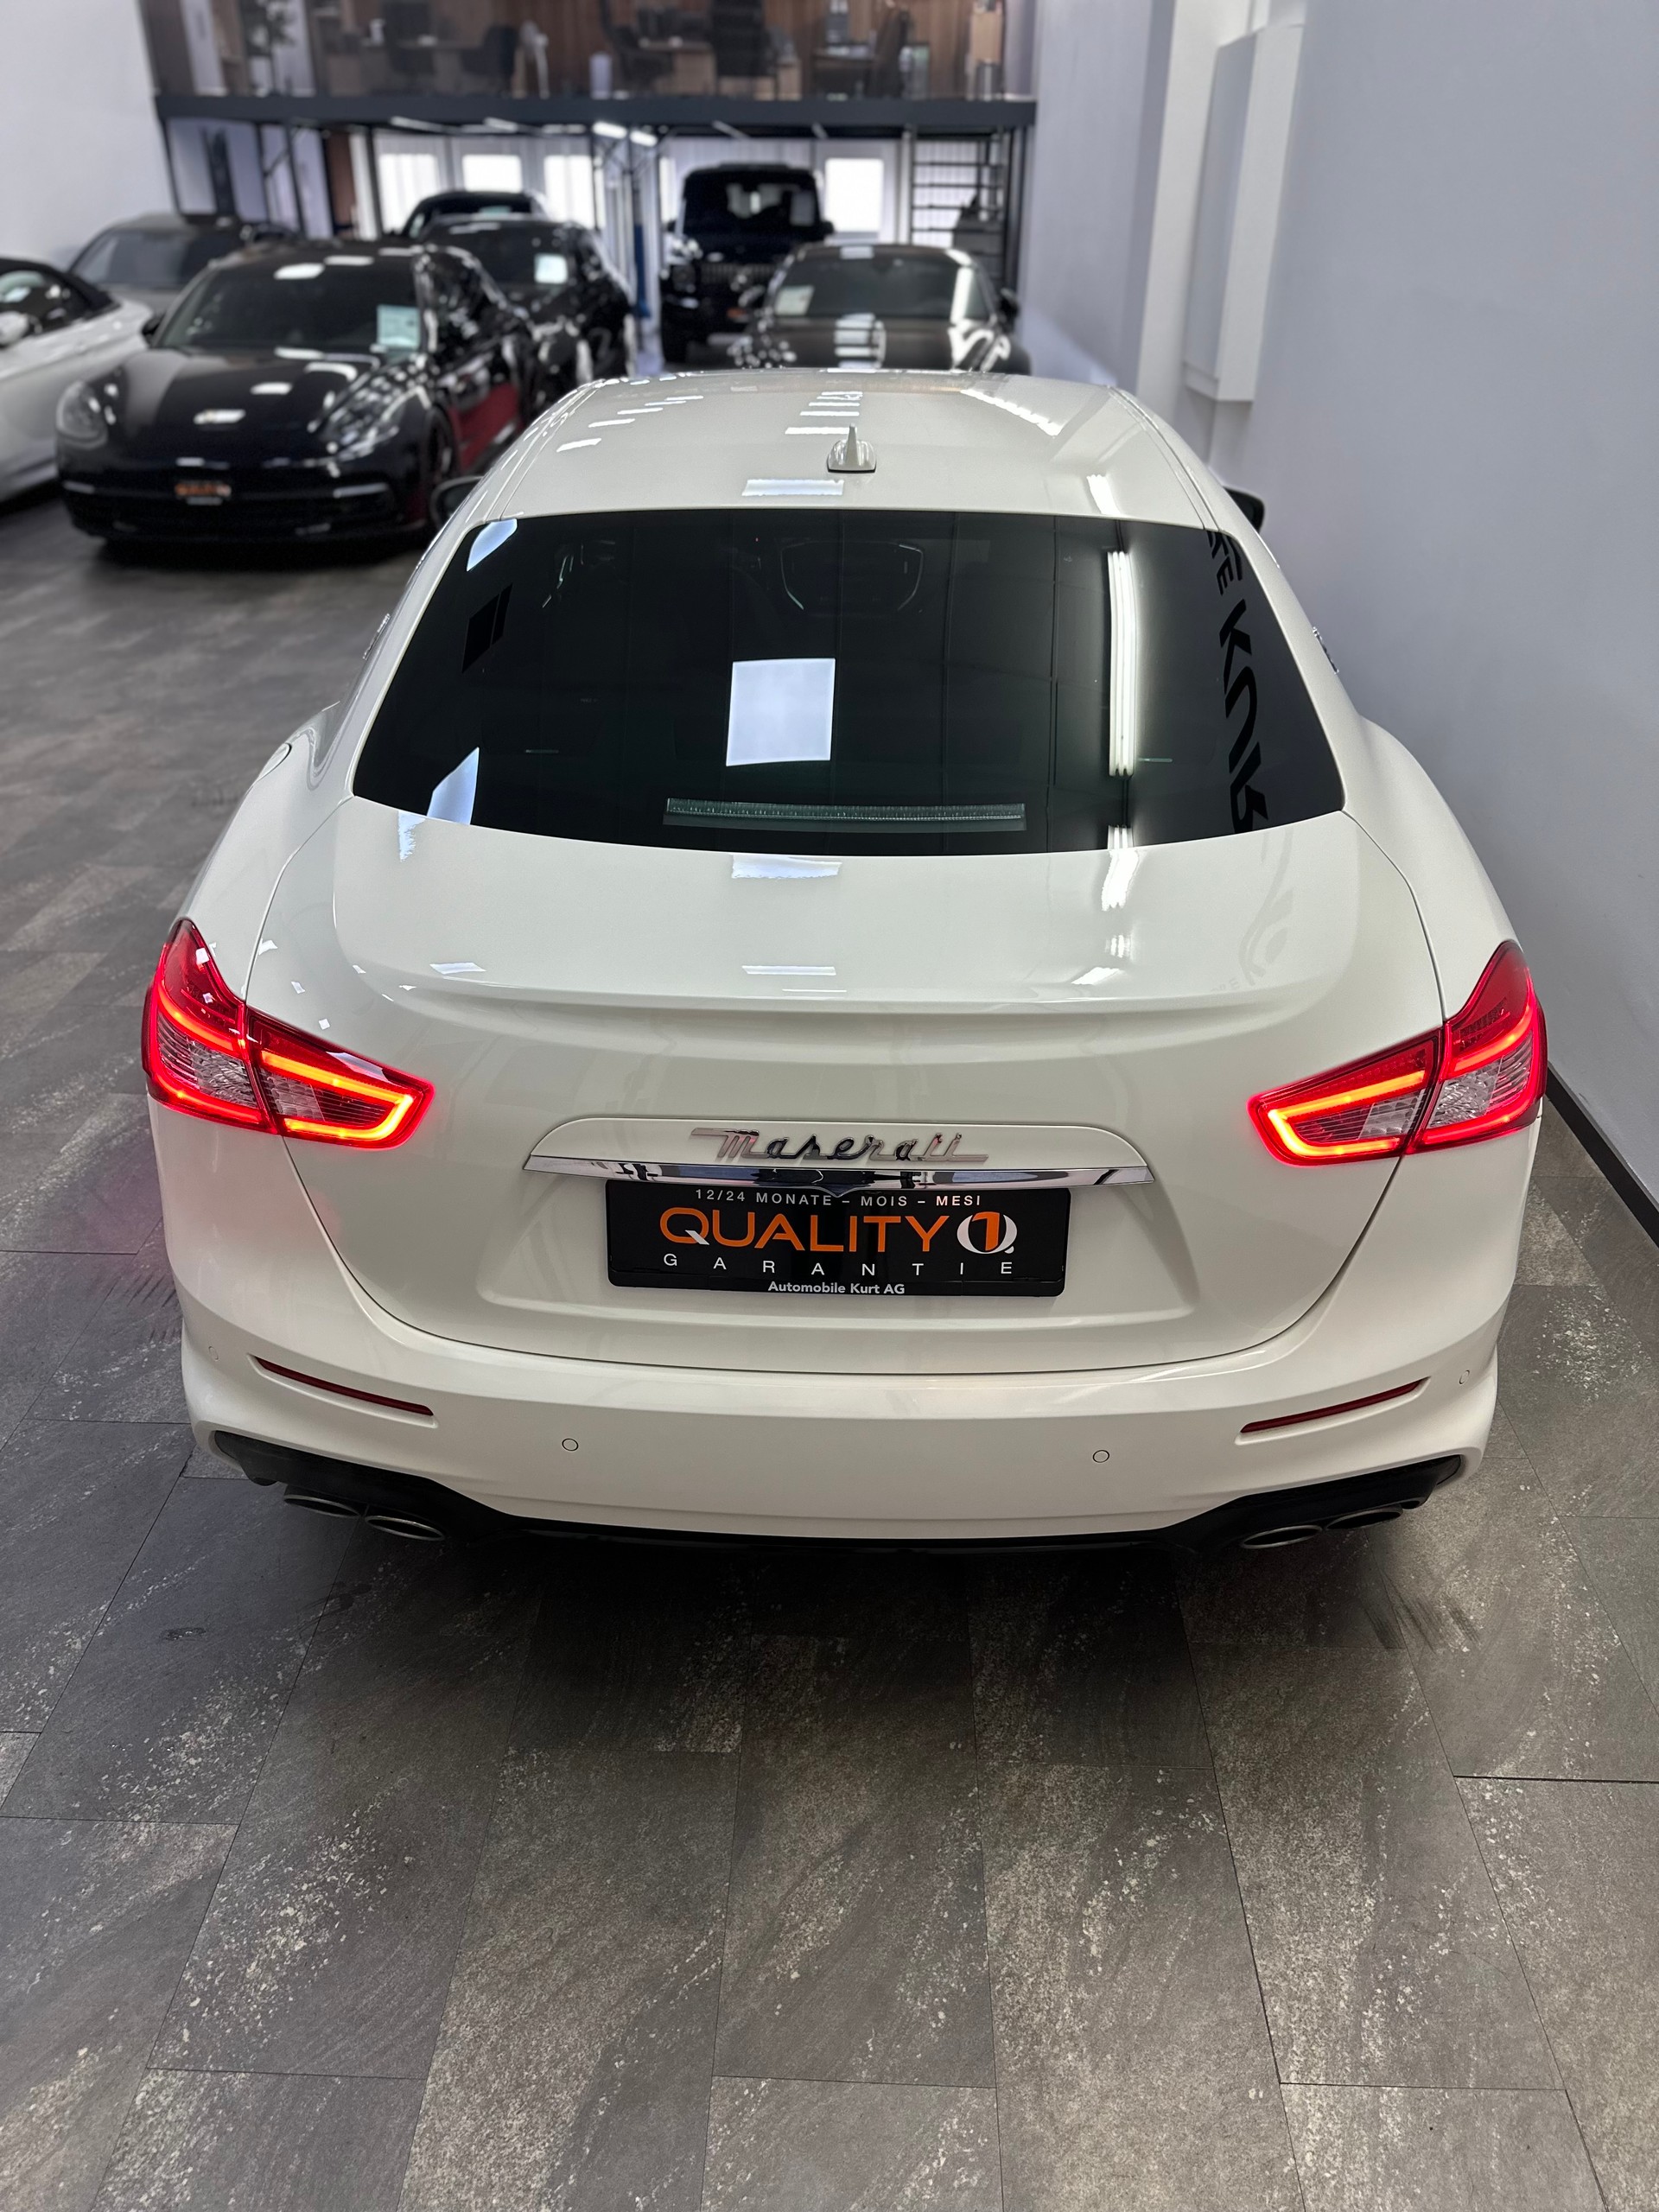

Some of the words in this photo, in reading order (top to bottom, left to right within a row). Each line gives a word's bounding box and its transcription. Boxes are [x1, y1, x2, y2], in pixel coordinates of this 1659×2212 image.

[691, 1127, 988, 1161] Maserati
[695, 1188, 746, 1203] 12/24
[755, 1192, 832, 1206] MONATE
[861, 1195, 908, 1207] MOIS
[936, 1195, 981, 1207] MESI
[659, 1206, 950, 1253] QUALITY
[663, 1253, 1013, 1276] GARANTIE
[767, 1281, 846, 1294] Automobile
[849, 1282, 880, 1294] Kurt
[883, 1283, 906, 1294] AG
